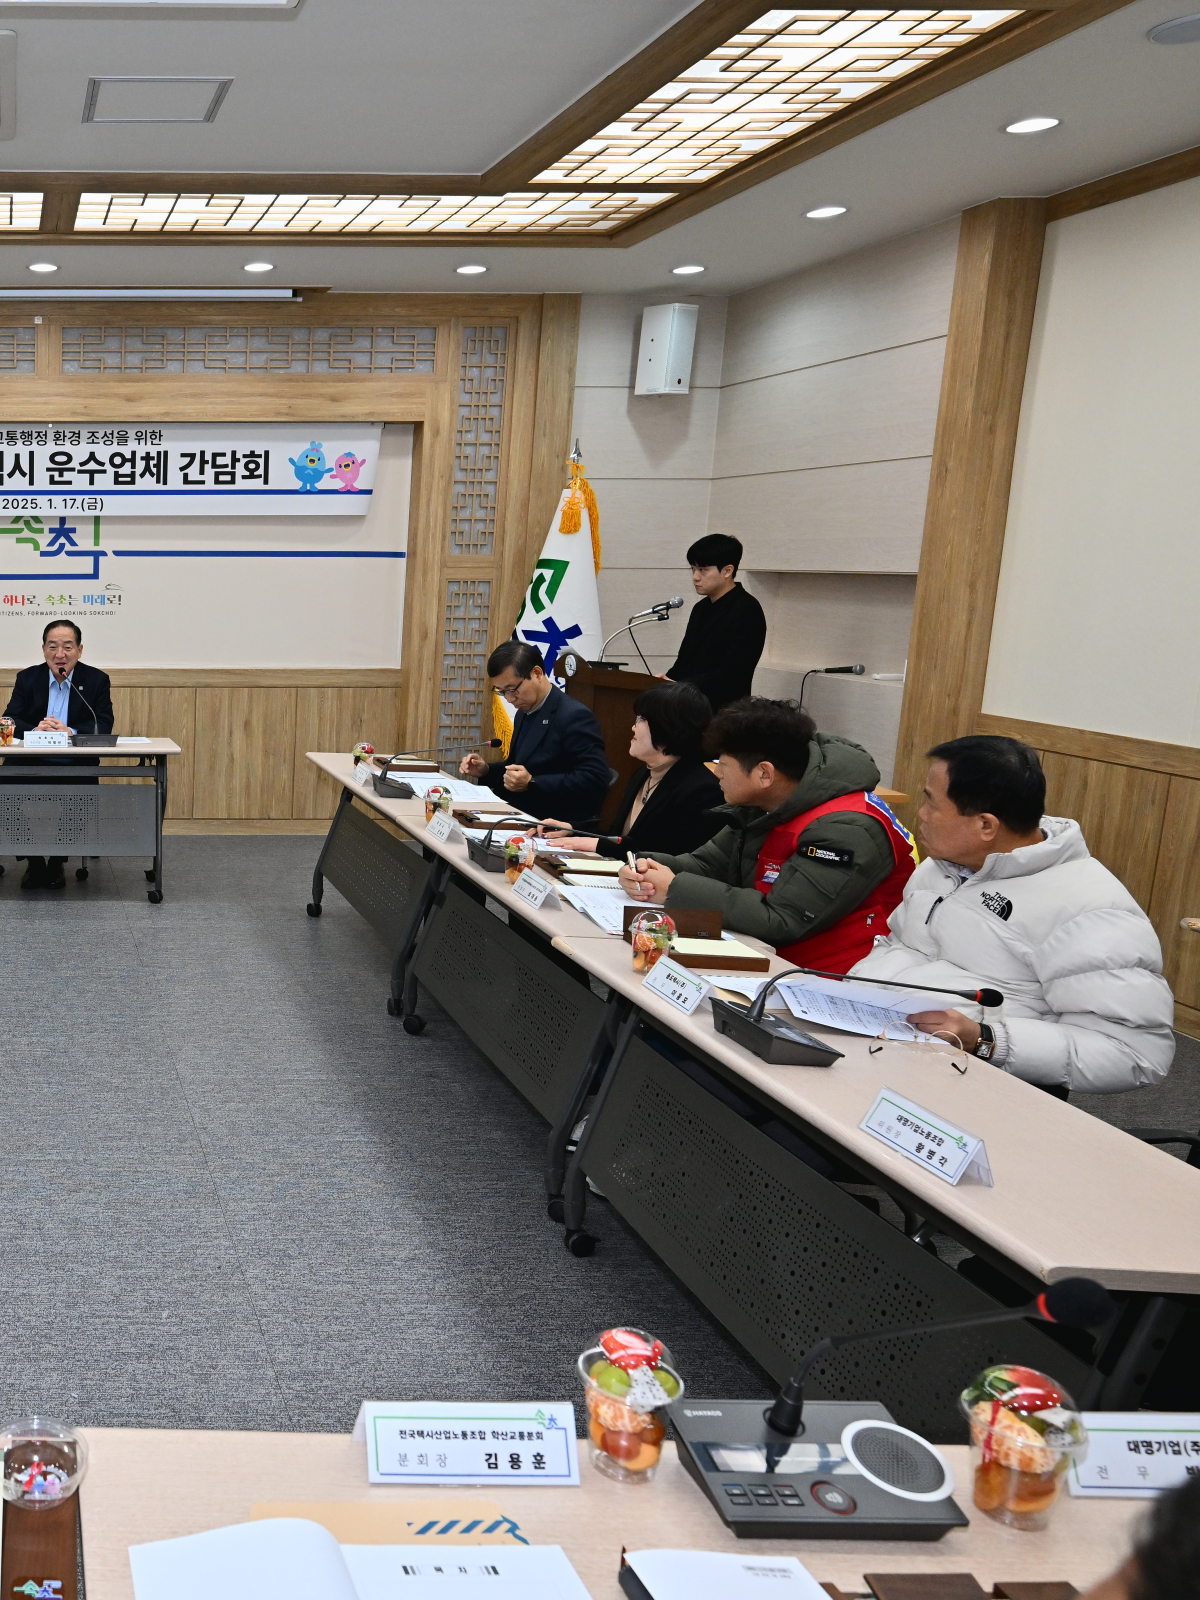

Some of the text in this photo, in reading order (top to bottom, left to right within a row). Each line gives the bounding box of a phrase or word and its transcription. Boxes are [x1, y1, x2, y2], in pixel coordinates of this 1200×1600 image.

[52, 430, 81, 446] 환경
[86, 430, 130, 446] 조성을
[134, 430, 163, 446] 위한
[45, 450, 168, 486] 운수업체
[178, 450, 271, 486] 간담회
[1, 499, 43, 511] 2025.
[47, 499, 58, 511] 1.
[2, 594, 41, 607] 하나로,
[45, 594, 79, 607] 속초는
[82, 594, 123, 607] 미래로!
[980, 891, 1002, 908] NORTH
[993, 891, 1008, 903] THE
[981, 899, 999, 914] FACE
[399, 1429, 544, 1441] 전국택시산업노동조합 학산교통분회
